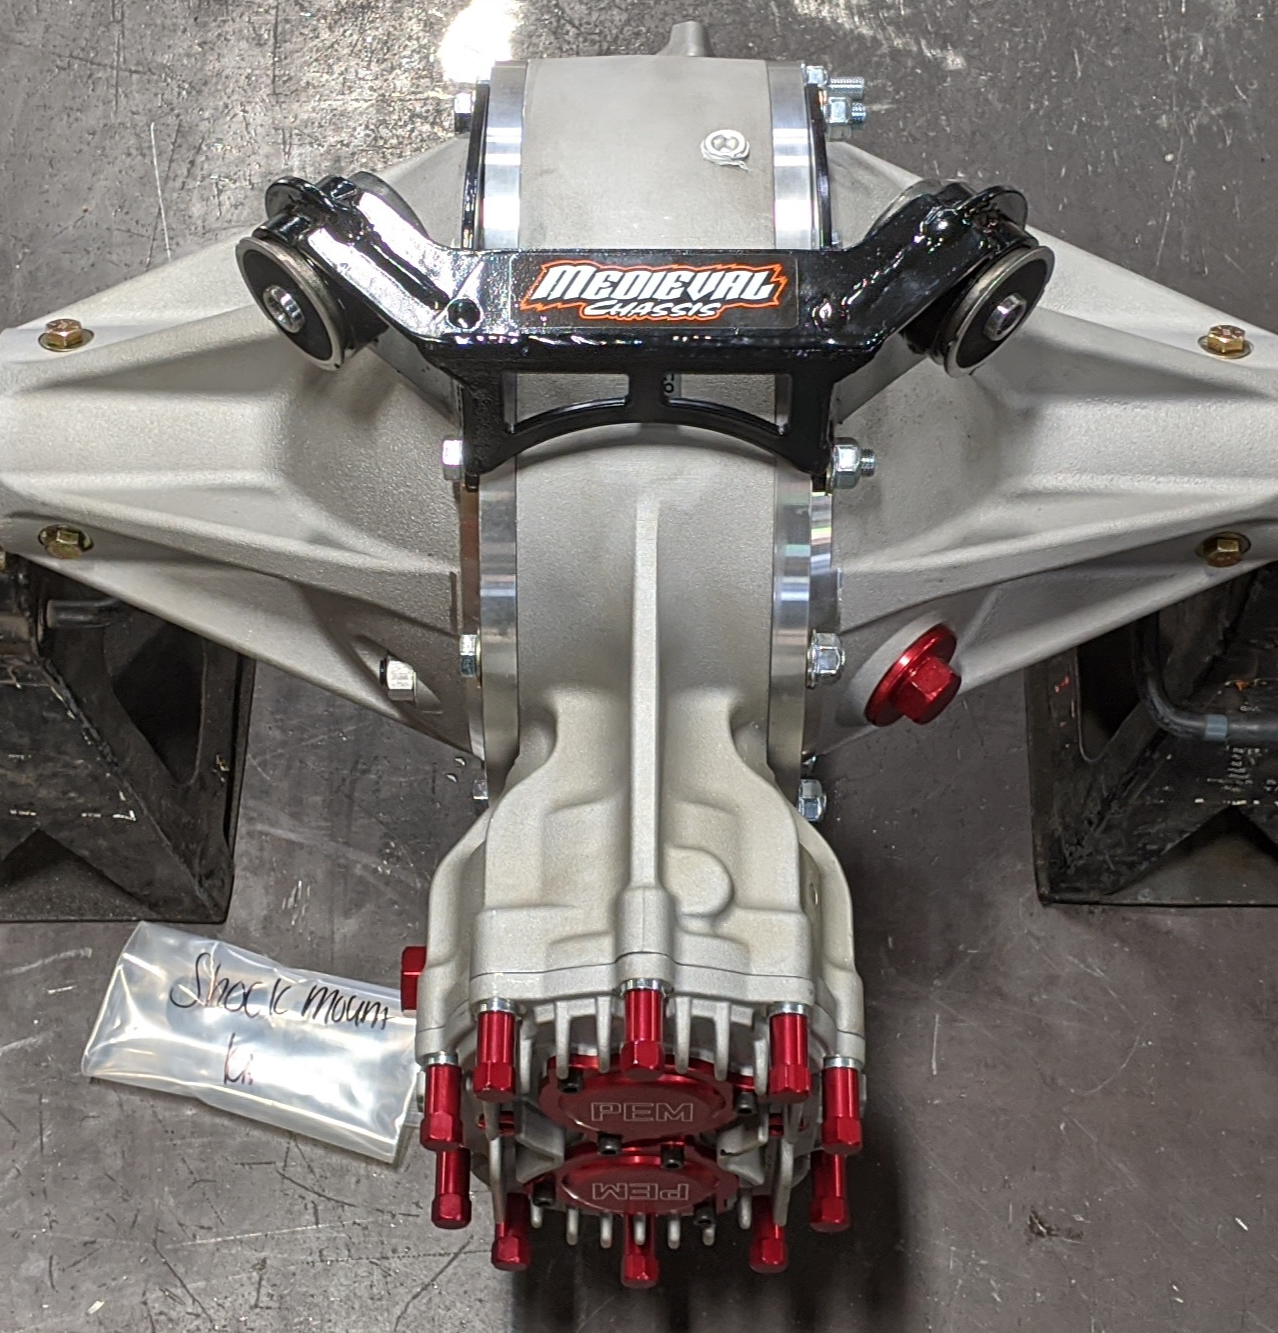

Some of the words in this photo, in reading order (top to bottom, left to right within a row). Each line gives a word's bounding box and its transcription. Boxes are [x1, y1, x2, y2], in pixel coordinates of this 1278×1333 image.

[532, 265, 775, 301] MEDIEVAL
[583, 300, 721, 317] CHASSIS
[169, 952, 291, 1018] Shock
[591, 1102, 694, 1122] PEM
[592, 1183, 689, 1200] PEM
